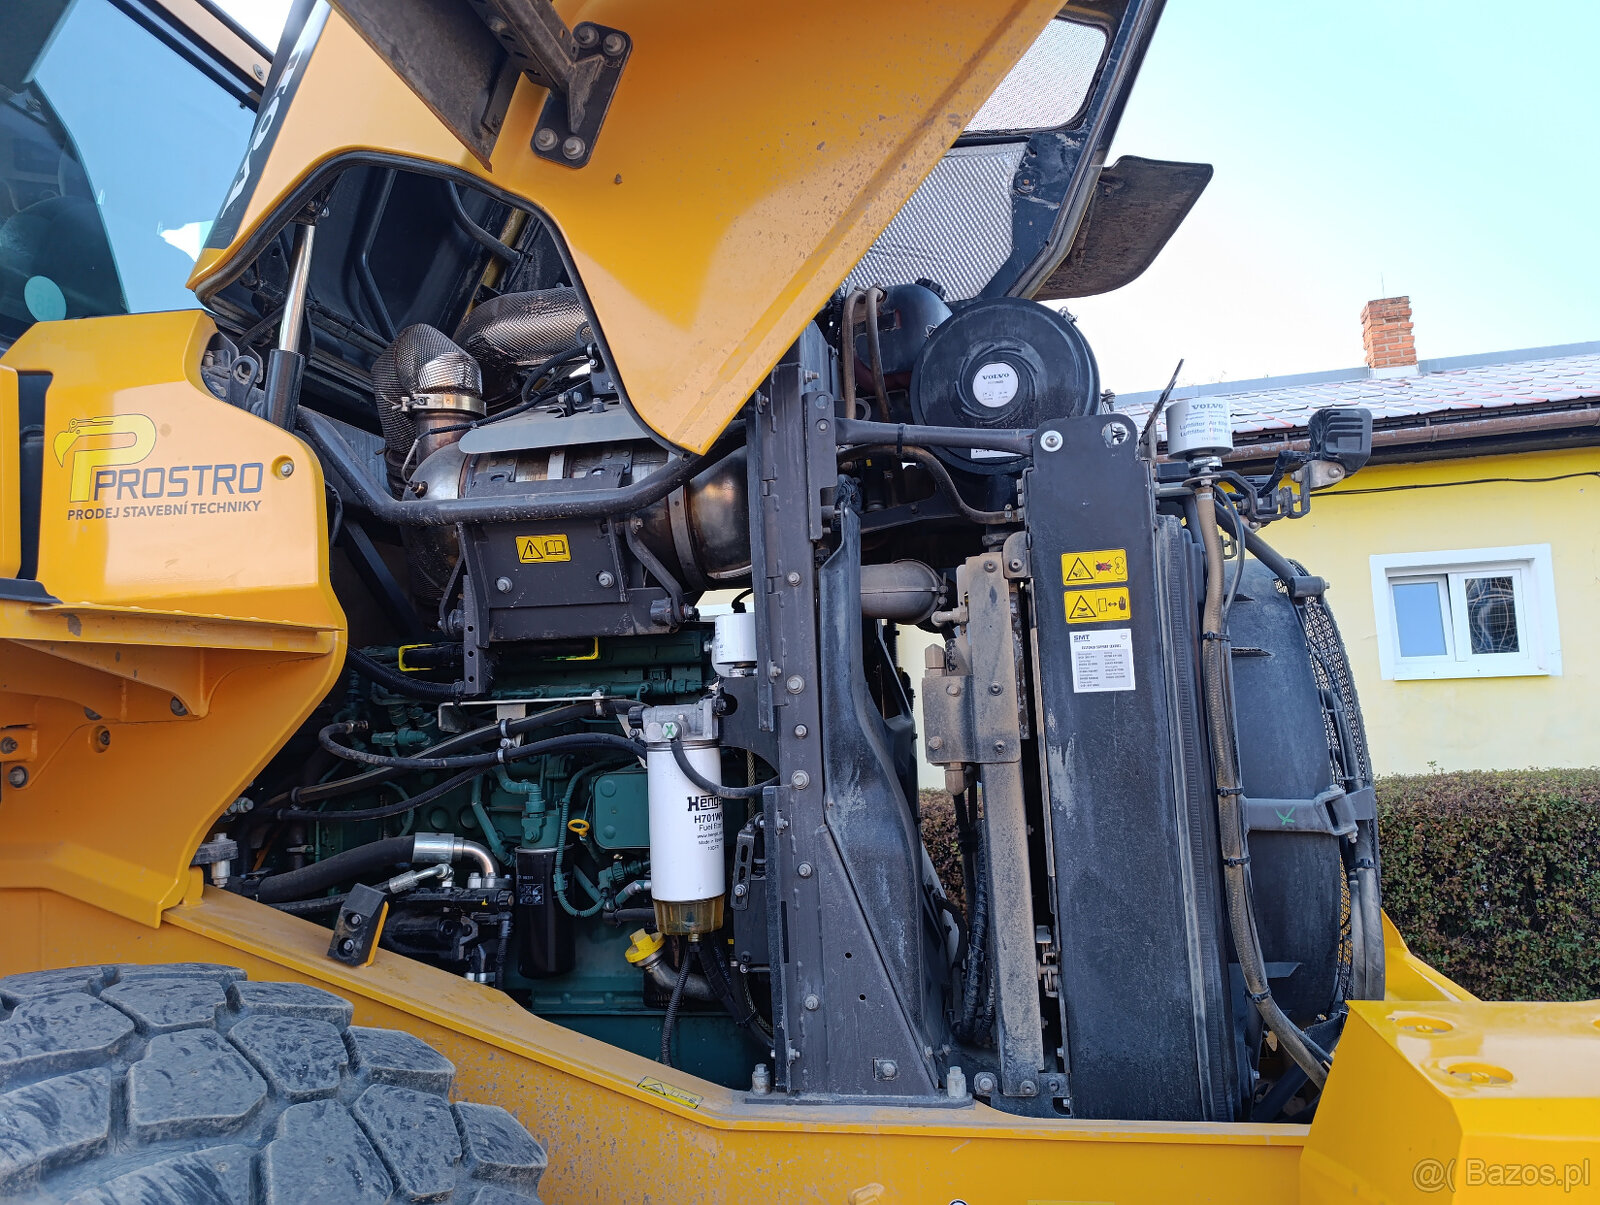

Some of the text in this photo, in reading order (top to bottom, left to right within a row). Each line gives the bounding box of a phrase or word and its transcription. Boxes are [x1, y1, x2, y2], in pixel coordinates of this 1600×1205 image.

[94, 462, 264, 501] PROSTRO
[67, 500, 262, 520] PRODEJ STAVEBNÍ TECHNIKY
